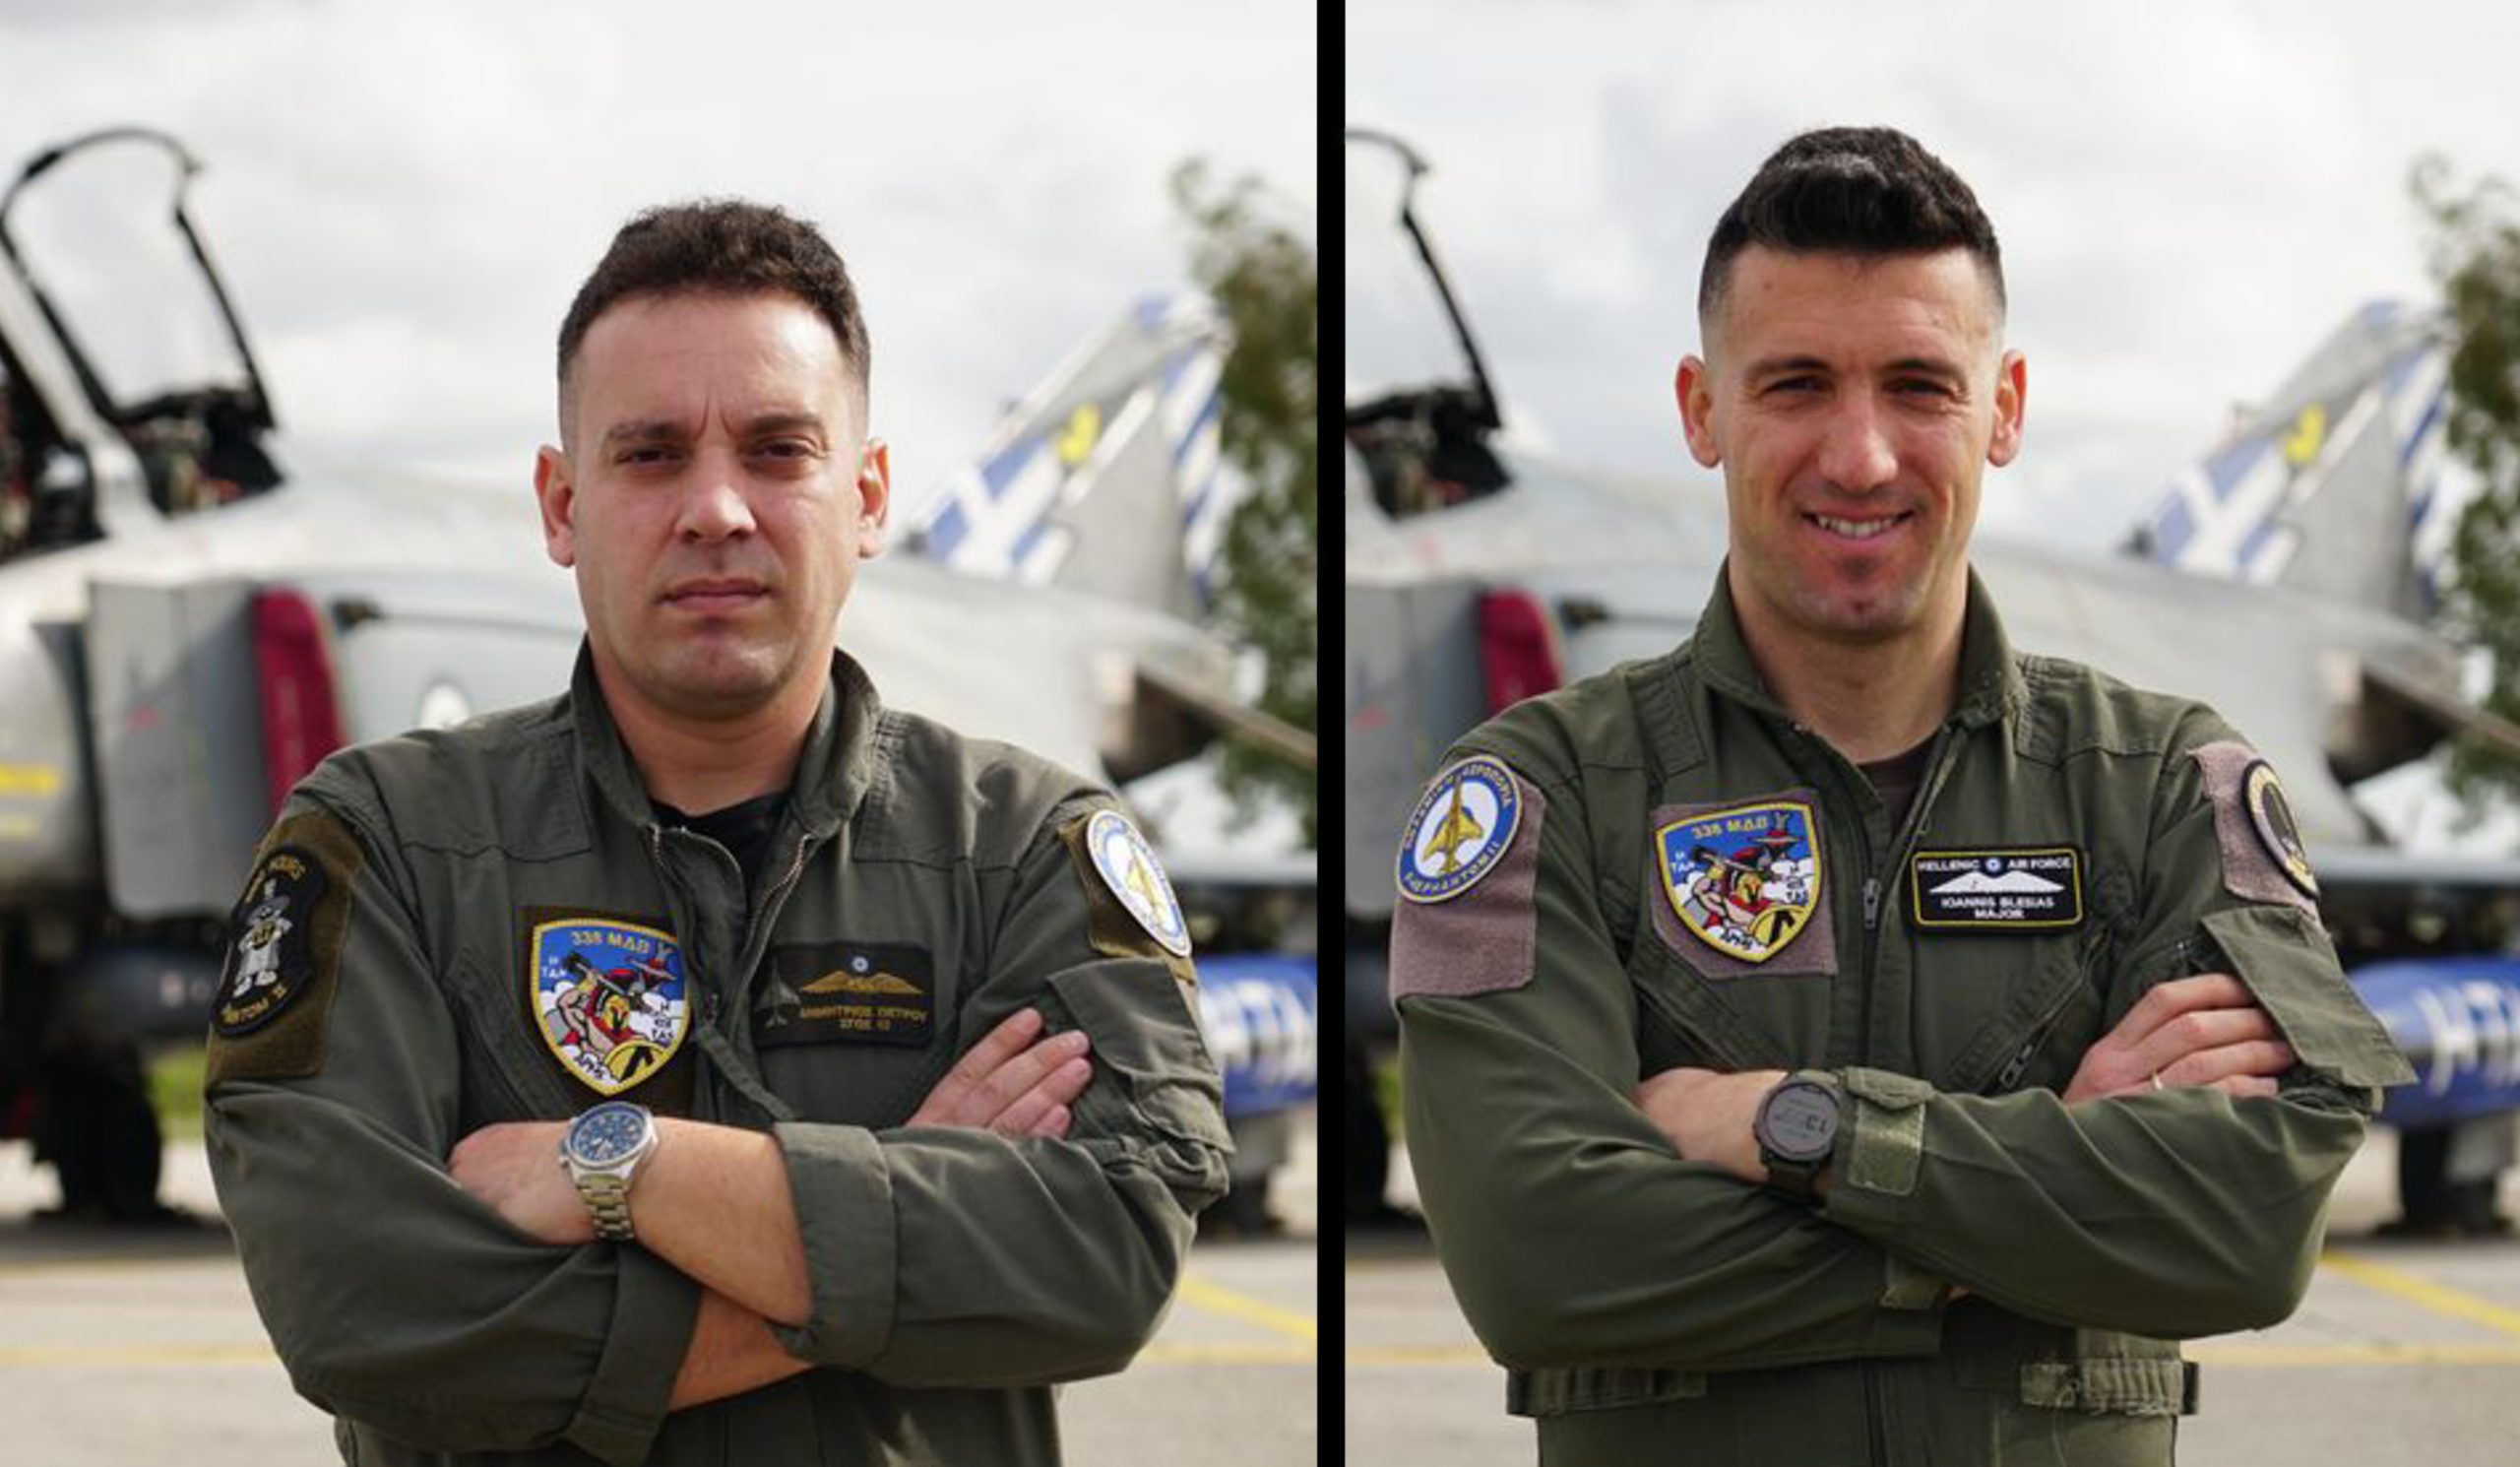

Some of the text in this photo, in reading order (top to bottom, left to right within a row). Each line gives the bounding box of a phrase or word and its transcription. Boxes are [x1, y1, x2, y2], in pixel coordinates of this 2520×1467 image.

[1918, 857, 2072, 871] HELLENIC AIR FORCE
[1940, 896, 2054, 909] IOANNIS BLESIAS
[1975, 909, 2025, 920] MAJOR
